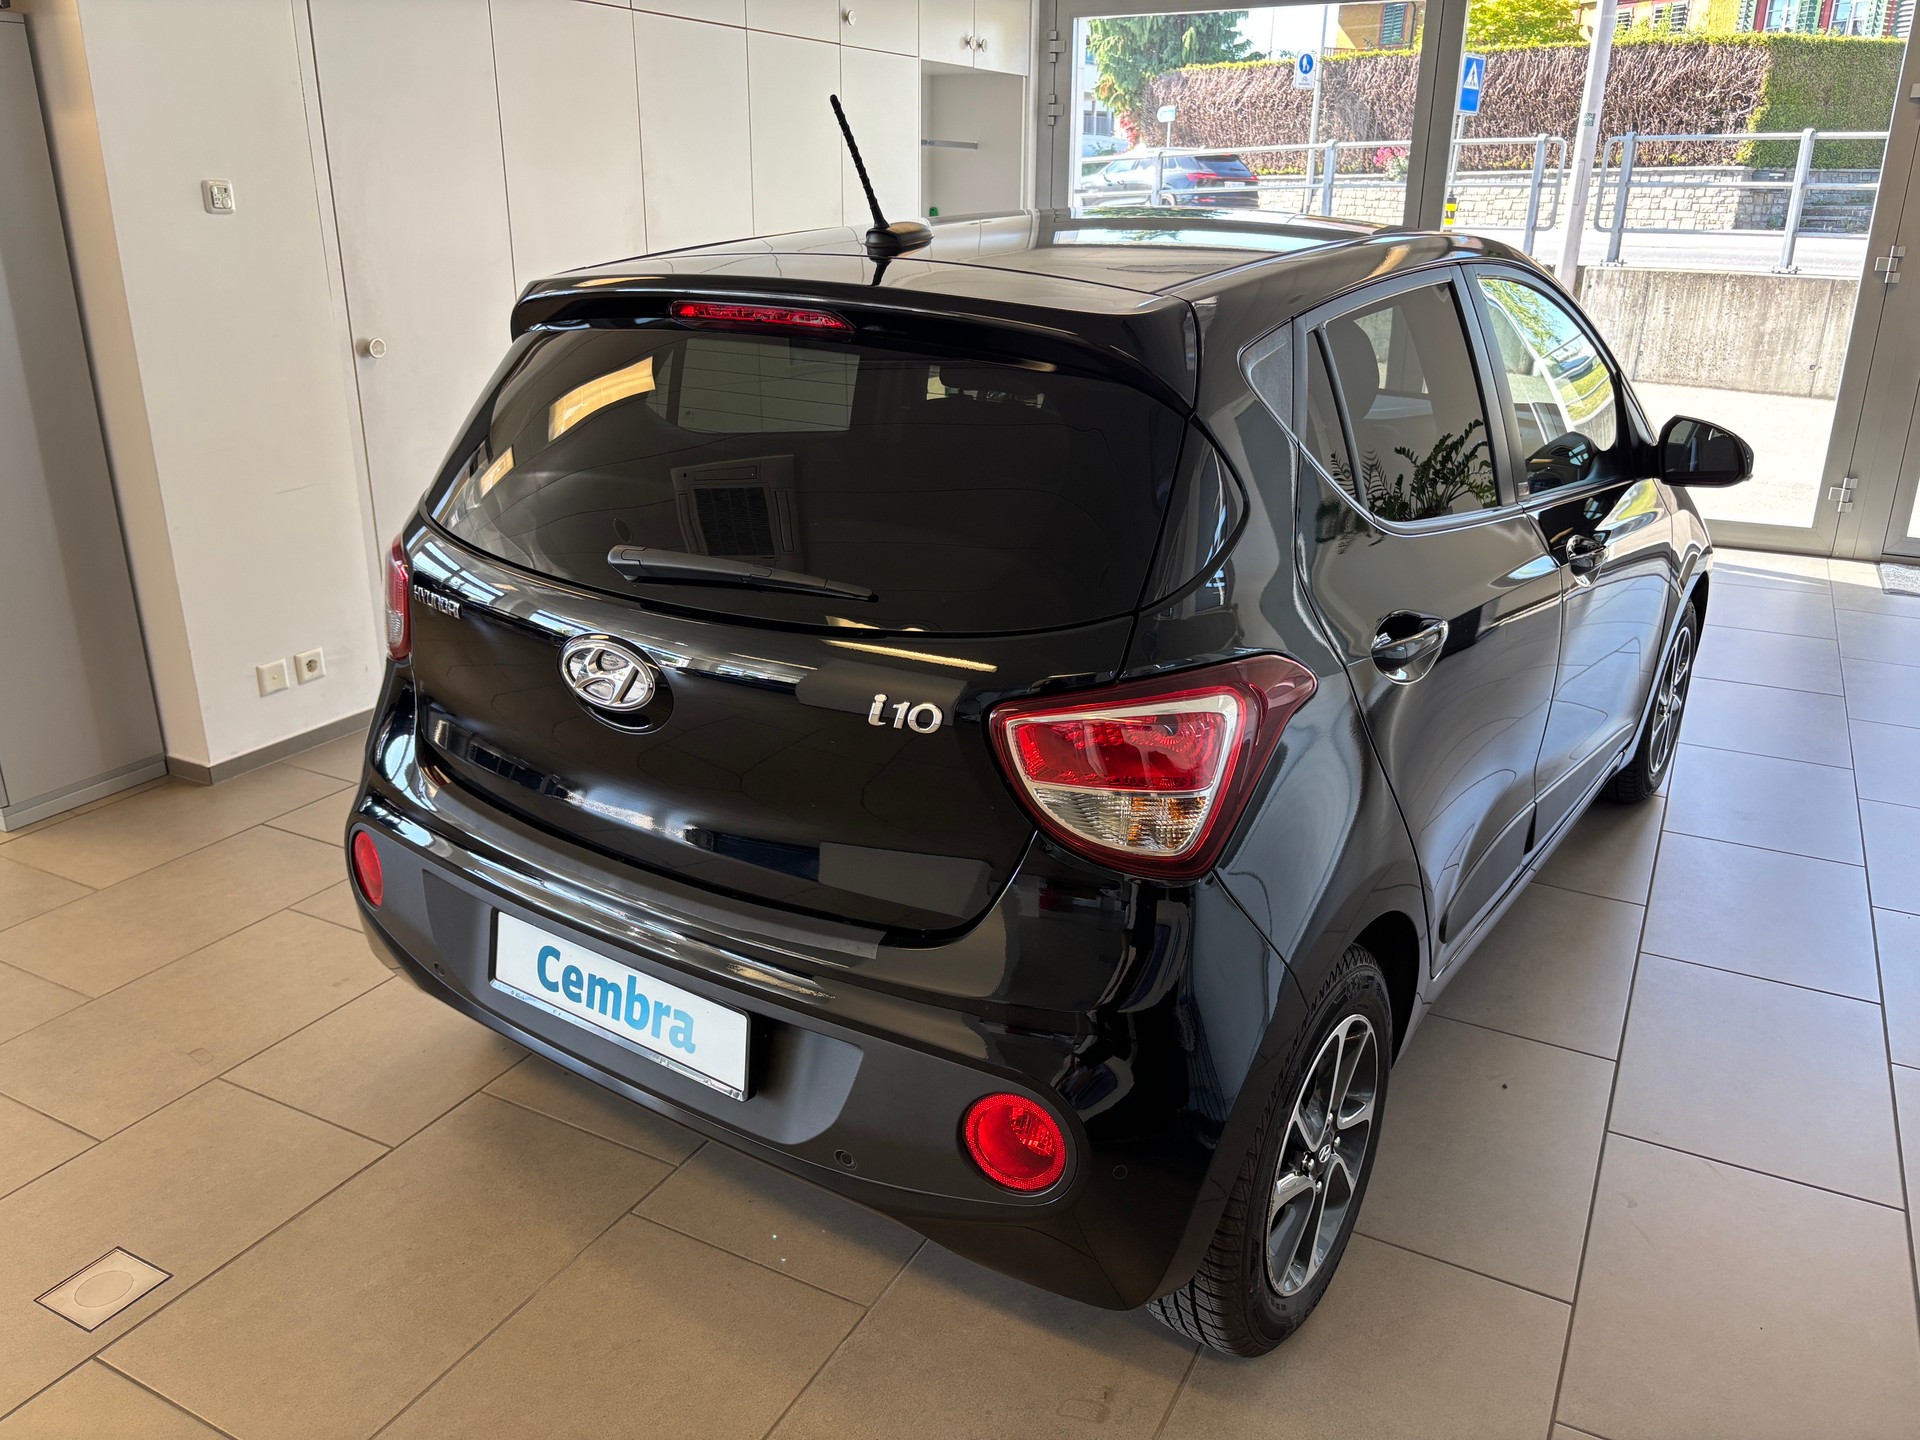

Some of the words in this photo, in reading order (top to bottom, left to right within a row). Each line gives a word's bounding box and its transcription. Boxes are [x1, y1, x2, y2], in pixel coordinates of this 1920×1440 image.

[413, 584, 461, 620] HYUNDAI
[867, 693, 943, 734] i10
[536, 945, 696, 1054] Cembra
